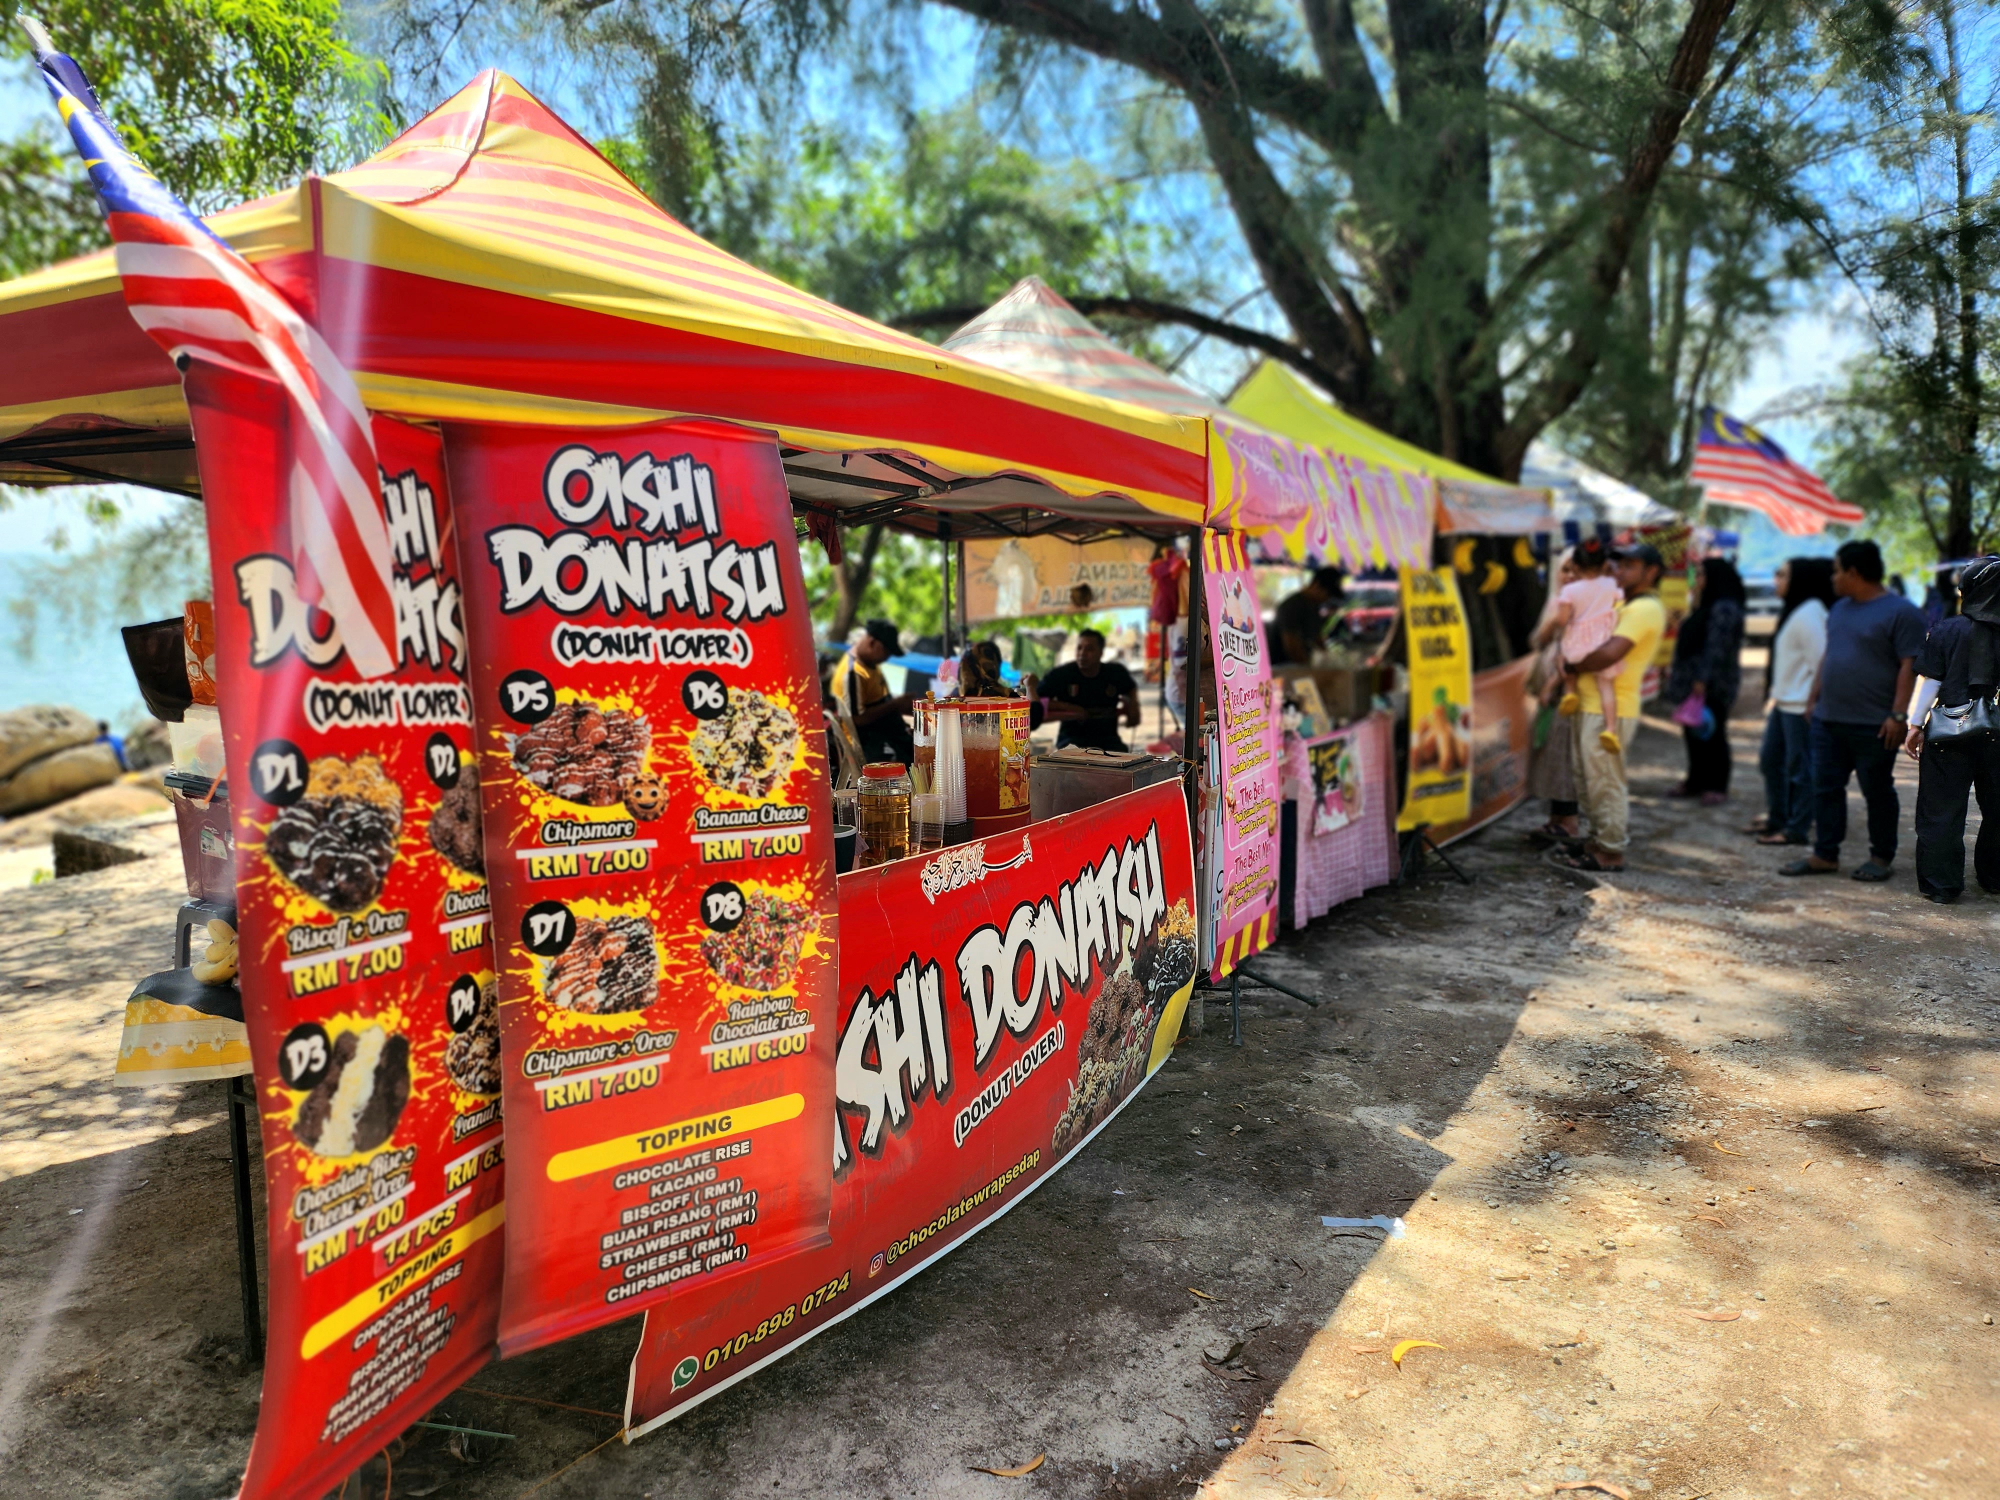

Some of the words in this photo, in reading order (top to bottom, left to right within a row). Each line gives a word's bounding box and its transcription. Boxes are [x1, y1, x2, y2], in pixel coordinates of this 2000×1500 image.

[547, 446, 720, 536] OISHI
[487, 527, 787, 622] DONATSU
[557, 627, 652, 663] (DONUT
[660, 630, 751, 664] LOVER)
[1219, 630, 1240, 653] SWEET
[309, 685, 398, 727] (DONUT
[507, 680, 548, 713] D5
[688, 681, 724, 710] D6
[1004, 717, 1018, 729] TEH
[257, 753, 303, 794] D1
[430, 744, 456, 779] D2
[542, 821, 634, 846] Chipsmore
[697, 808, 758, 829] Banana
[760, 804, 807, 825] Cheese
[530, 852, 579, 880] RM
[588, 847, 648, 874] 7.00
[703, 839, 743, 862] RM
[749, 833, 802, 859] 7.00
[446, 887, 489, 915] Chocol
[707, 893, 742, 924] D8
[288, 916, 350, 952] Biscoff
[367, 911, 405, 933] Oreo
[451, 922, 483, 952] RM
[529, 910, 567, 947] D7
[957, 822, 1166, 1067] DONATSU
[293, 960, 338, 995] RM
[346, 944, 402, 981] 7.00
[450, 986, 475, 1025] D4
[729, 996, 791, 1022] Rainbow
[712, 1015, 778, 1043] Chocolate
[780, 1011, 807, 1032] rice
[286, 1034, 327, 1082] D3
[525, 1040, 617, 1076] Chipsmore
[634, 1031, 675, 1053] Oreo
[712, 1046, 750, 1071] RM
[757, 1033, 806, 1062] 6.00
[833, 956, 949, 1173] SHI
[545, 1079, 591, 1109] RM
[600, 1063, 658, 1096] 7.00
[955, 1074, 1011, 1144] (DONUT
[1013, 1024, 1065, 1089] LOVER)
[637, 1115, 732, 1153] TOPPING
[448, 1155, 479, 1192] RM
[615, 1151, 711, 1188] CHOCOLATE
[715, 1141, 750, 1161] RISE
[650, 1168, 717, 1197] KACANG
[602, 1225, 648, 1250] BUAH
[653, 1204, 711, 1234] PISANG
[715, 1190, 758, 1216] (RM1)
[622, 1192, 690, 1225] BISCOFF
[886, 1148, 1041, 1264] @chocolatewrapsedap
[306, 1231, 347, 1274] RM
[355, 1199, 405, 1245] 7.00
[384, 1234, 411, 1265] 14
[416, 1202, 457, 1246] PCS
[601, 1222, 711, 1269] STRAWBERRY
[714, 1208, 757, 1233] (RM1)
[377, 1238, 454, 1303] TOPPING
[607, 1261, 702, 1302] CHIPSMORE
[706, 1245, 747, 1271] (RM1)
[624, 1246, 687, 1279] CHEESE
[692, 1232, 734, 1258] (RM1)
[353, 1283, 431, 1351] CHOCOLATE
[431, 1262, 464, 1292] RISE
[703, 1304, 797, 1372] 010-898
[801, 1271, 850, 1317] 0724
